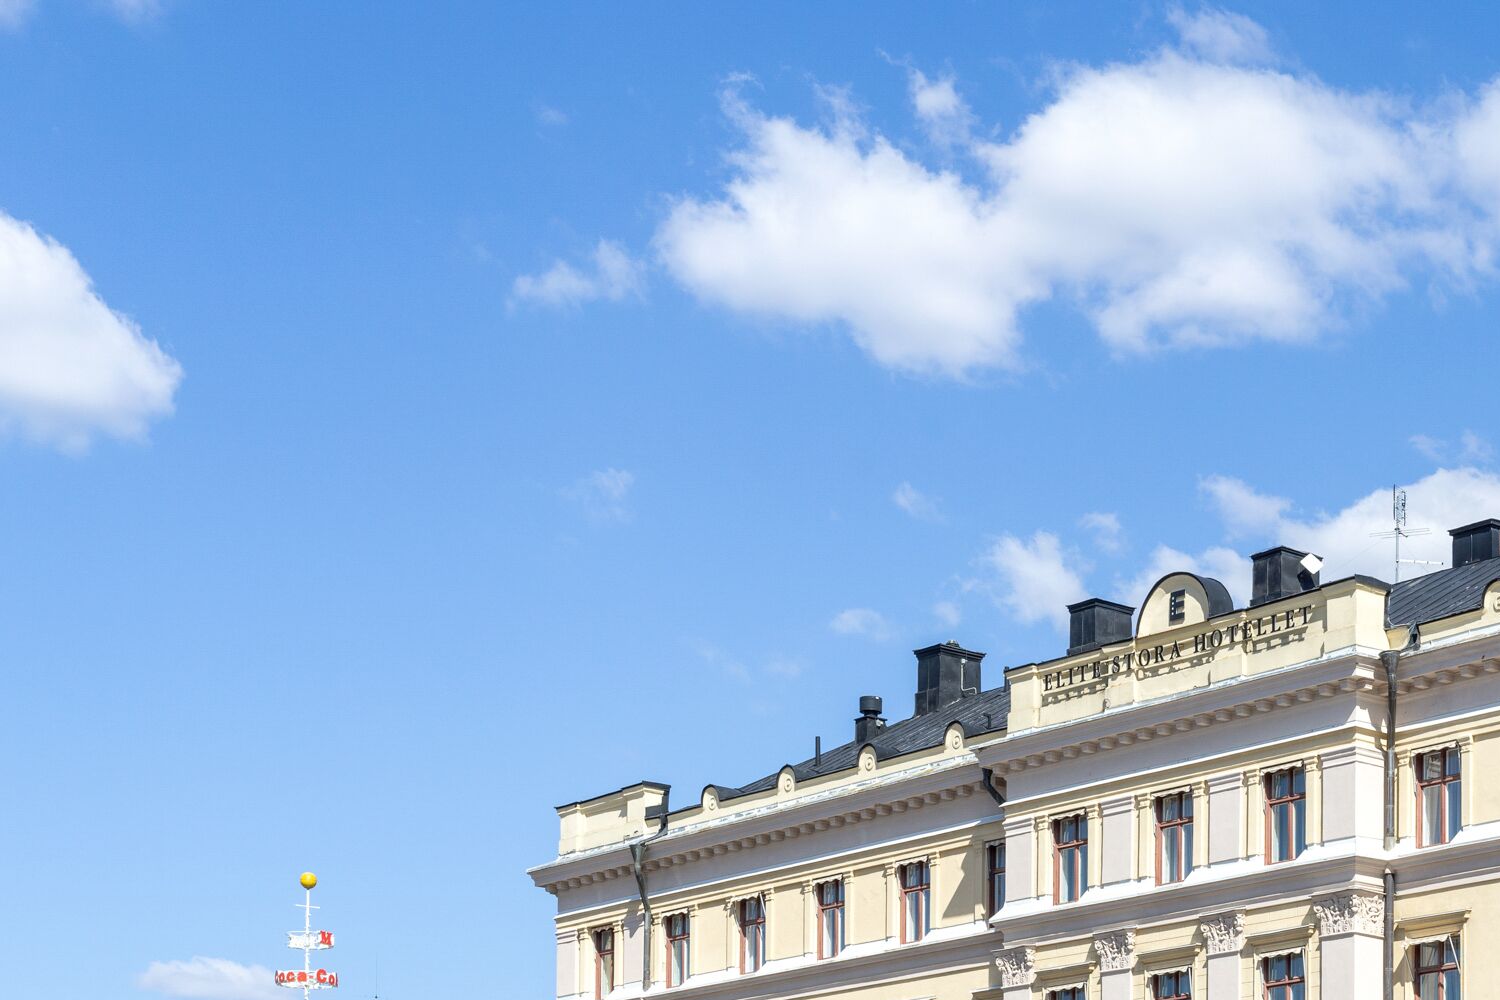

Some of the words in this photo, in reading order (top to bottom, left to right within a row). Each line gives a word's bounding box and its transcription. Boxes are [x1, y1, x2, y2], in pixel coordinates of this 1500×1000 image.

[1044, 661, 1101, 692] ELITE
[1112, 640, 1181, 674] STORA
[1194, 605, 1313, 653] HOTELLET
